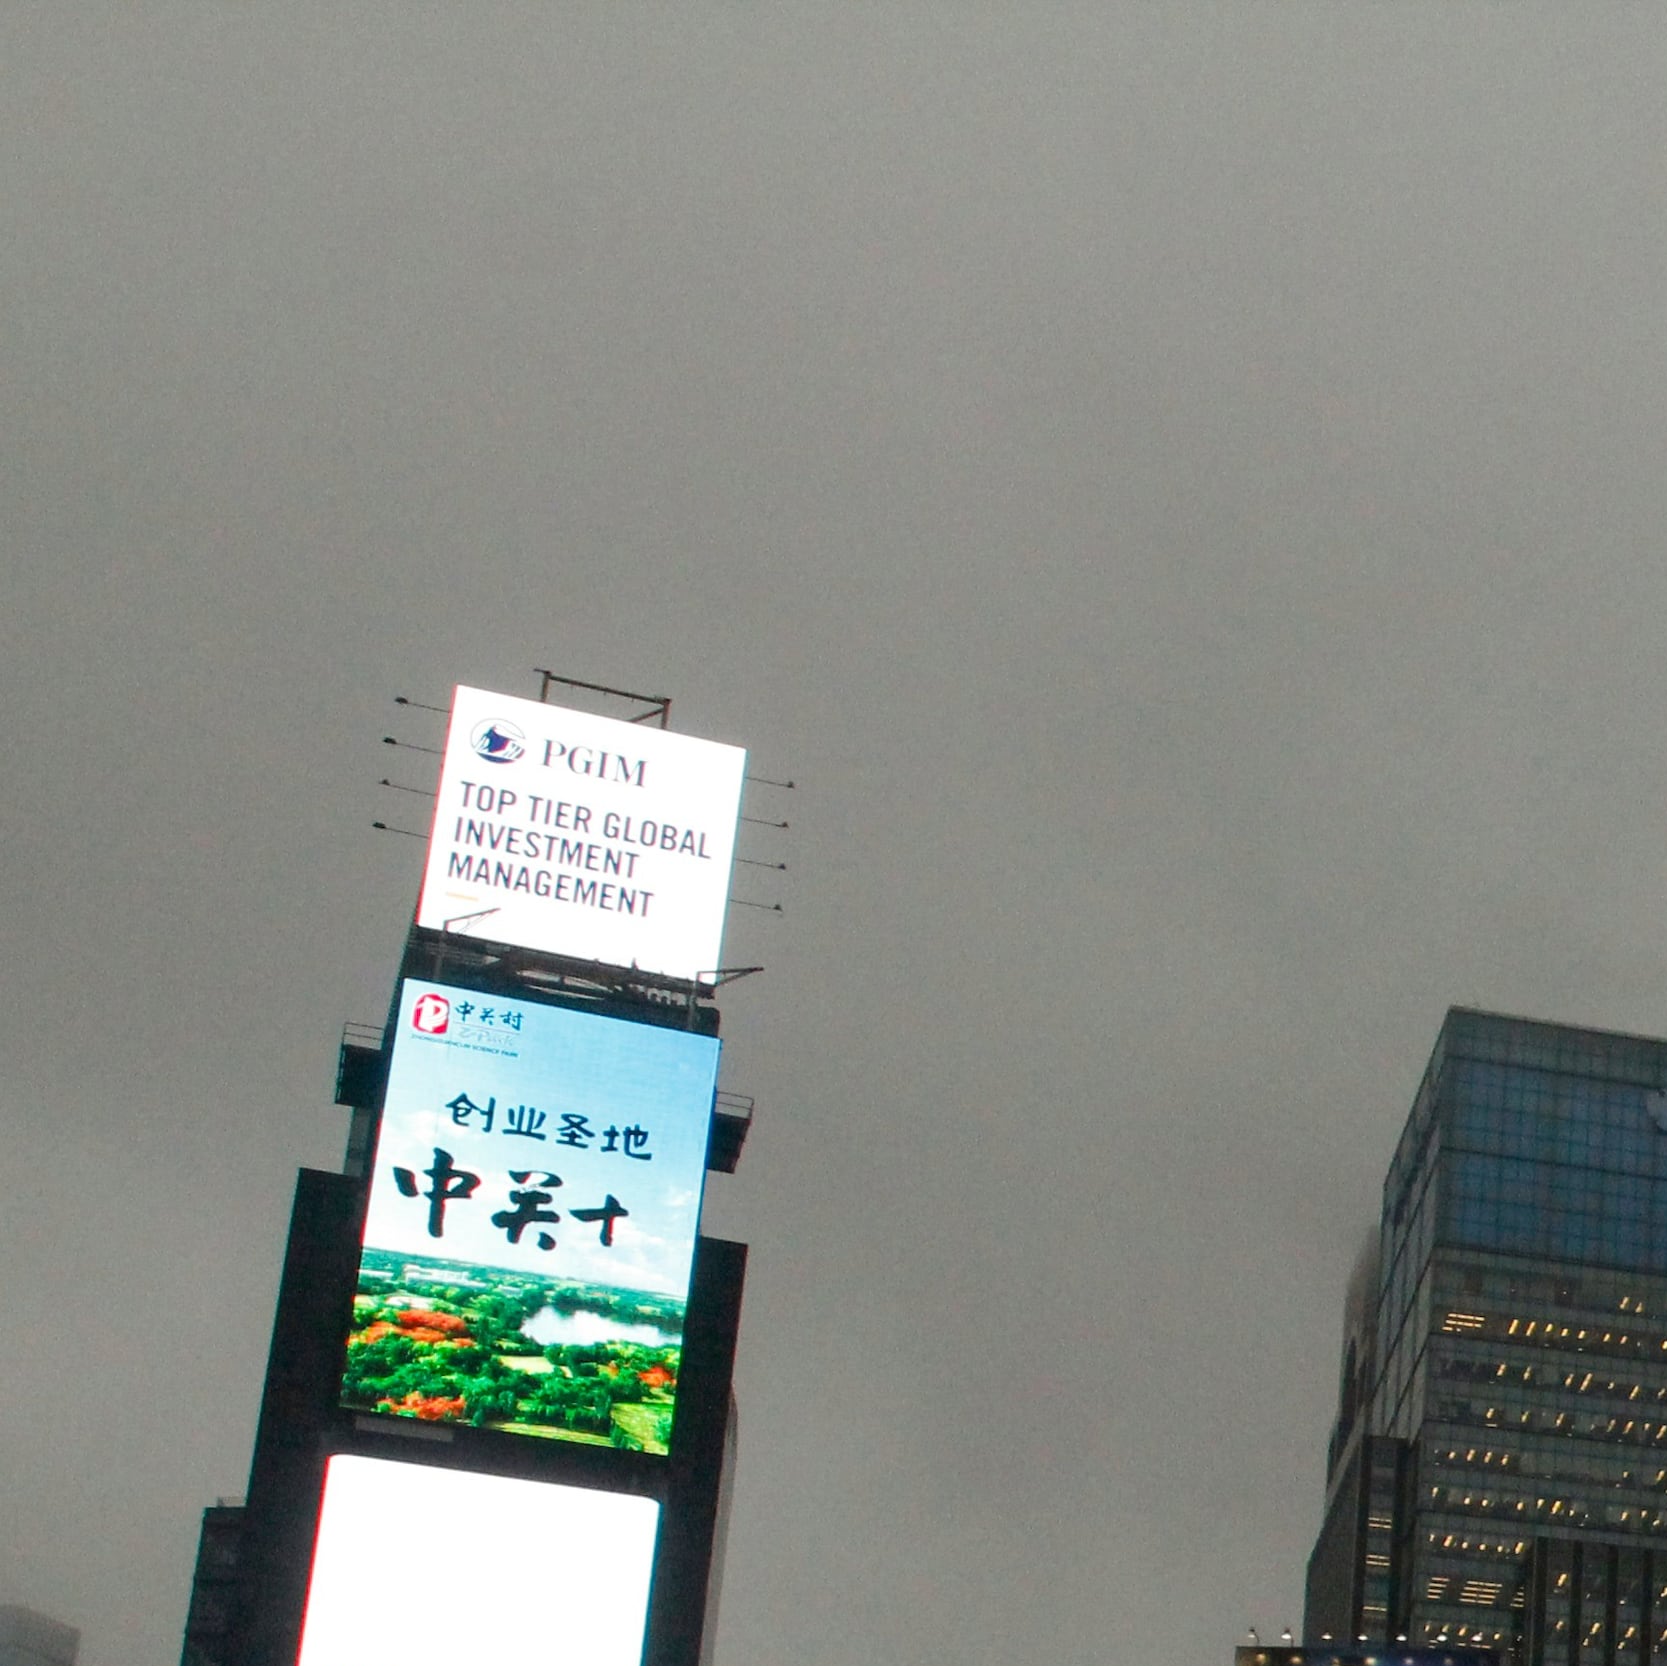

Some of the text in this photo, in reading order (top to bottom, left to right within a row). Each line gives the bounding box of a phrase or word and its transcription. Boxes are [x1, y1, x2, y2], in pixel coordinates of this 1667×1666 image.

[540, 739, 649, 787] PGIM
[454, 817, 640, 879] INVESTMENT
[460, 781, 712, 860] TOP TIER GLOBAL
[447, 852, 655, 918] MANAGEMENT
[455, 1001, 524, 1031] 中关村
[446, 1093, 652, 1161] 创业圣地
